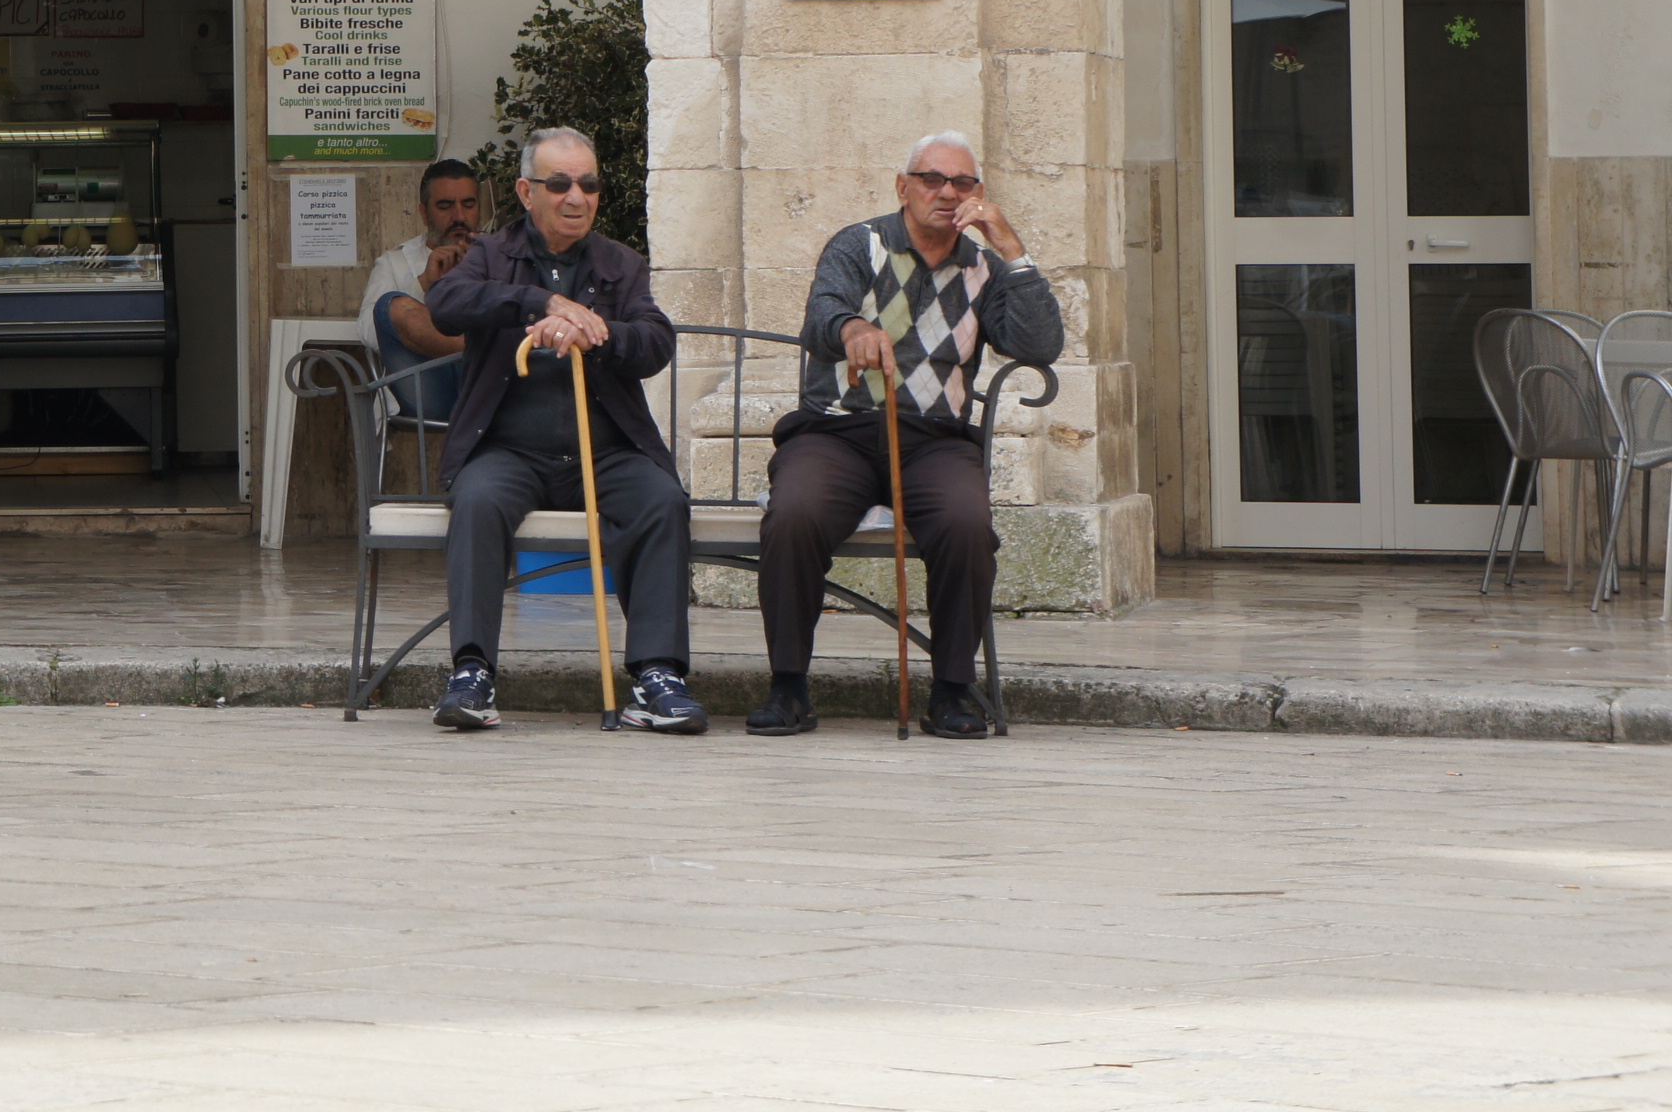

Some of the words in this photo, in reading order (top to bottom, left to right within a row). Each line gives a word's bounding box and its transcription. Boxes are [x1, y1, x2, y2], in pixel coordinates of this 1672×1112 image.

[291, 6, 339, 15] Various
[343, 5, 373, 15] flour
[378, 5, 412, 17] types
[300, 18, 343, 28] Bibite
[348, 18, 403, 28] fresche
[315, 31, 343, 40] Cool
[347, 31, 387, 40] drinks
[51, 50, 91, 58] PANINO
[303, 44, 348, 54] Taralli
[354, 46, 363, 54] e
[367, 44, 400, 54] frise
[302, 56, 341, 66] Taralli
[346, 56, 368, 66] and
[373, 56, 402, 66] frise
[283, 69, 319, 79] Pane
[325, 70, 361, 79] cotto
[367, 71, 375, 79] a
[380, 69, 420, 81] legna
[298, 83, 319, 94] dei
[325, 83, 406, 96] cappuccini
[280, 97, 320, 108] Capuchin's
[322, 97, 362, 106] wood-fired
[364, 97, 383, 106] brick
[404, 97, 425, 106] bread
[305, 109, 351, 119] Panini
[356, 108, 399, 119] farciti
[314, 122, 390, 131] sandwiches
[327, 138, 353, 147] tanto
[356, 138, 387, 147] altro...
[334, 147, 358, 155] much
[322, 190, 348, 199] pizzica
